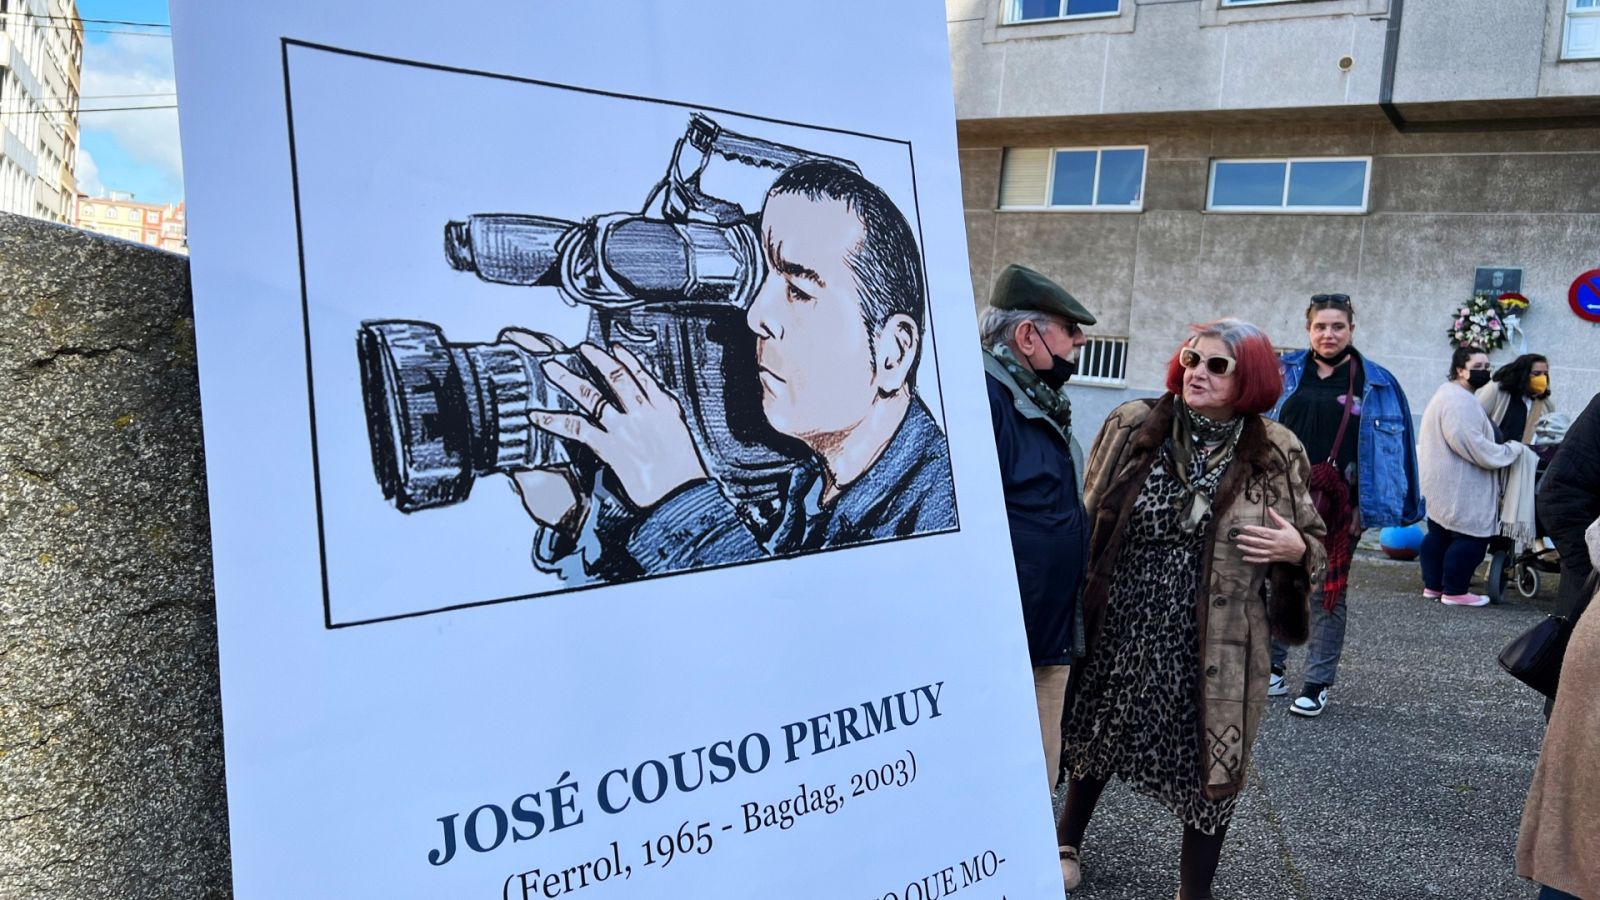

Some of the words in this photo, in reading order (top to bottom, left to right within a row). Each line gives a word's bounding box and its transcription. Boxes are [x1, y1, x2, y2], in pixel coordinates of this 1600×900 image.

[428, 770, 584, 866] JOSÉ
[597, 732, 771, 815] COUSO
[780, 681, 944, 764] PERMUY
[503, 841, 632, 900] (Ferrol,
[641, 820, 713, 868] 1965
[740, 783, 845, 834] Bagdag,
[850, 749, 917, 797] 2003)
[904, 866, 958, 900] QUE
[959, 850, 1006, 889] MO-
